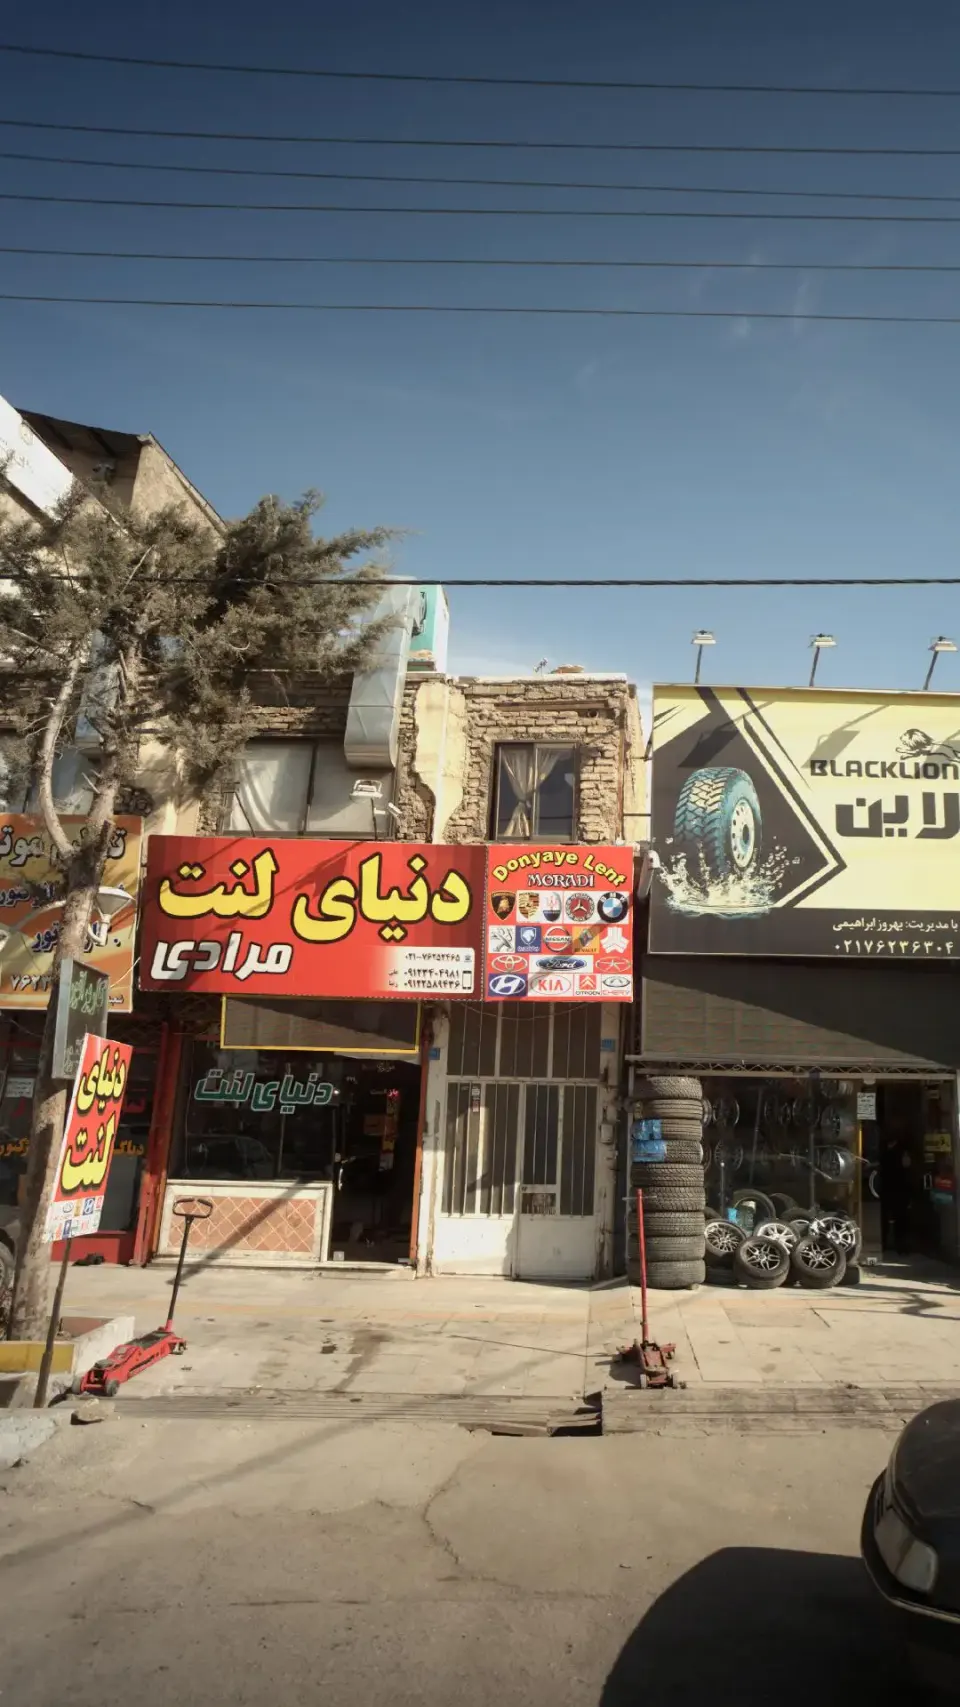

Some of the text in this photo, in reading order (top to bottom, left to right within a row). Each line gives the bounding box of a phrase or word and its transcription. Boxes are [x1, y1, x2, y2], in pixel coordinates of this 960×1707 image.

[159, 847, 280, 920] لنت
[491, 850, 627, 887] Donyaye Lent
[528, 873, 595, 888] MORADI
[291, 852, 472, 944] دنیای
[833, 917, 876, 931] ابراهیمی
[877, 919, 904, 932] بهروز
[150, 930, 294, 982] مرادی
[547, 958, 577, 969] Ford
[835, 940, 954, 954] ۰۲۱۷۶۲۳۶۳۰۴
[538, 979, 563, 991] KIA
[77, 1045, 127, 1115] دنیای
[194, 1069, 334, 1115] دنیای لنت
[60, 1110, 116, 1194] لنت
